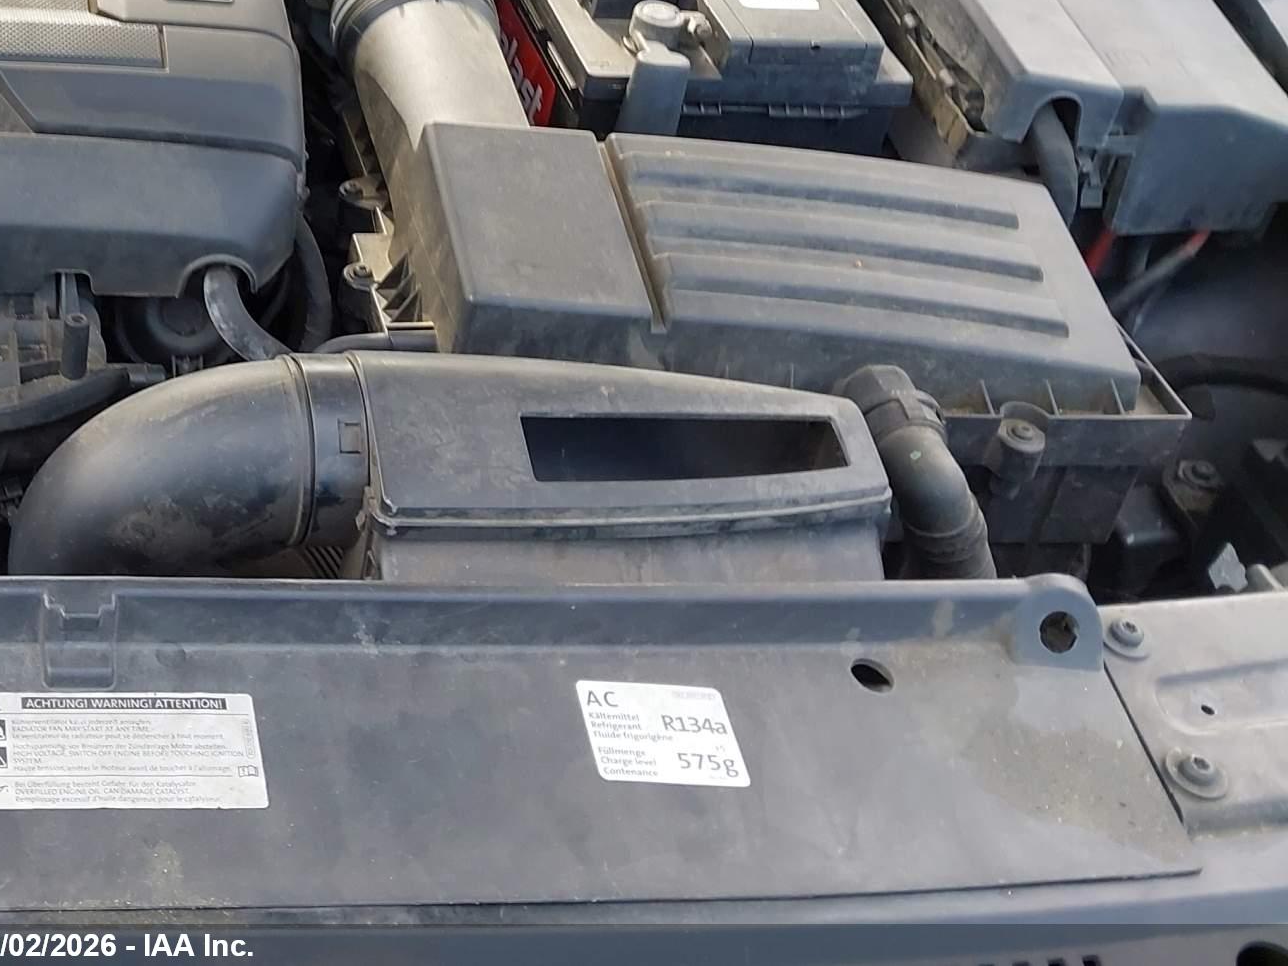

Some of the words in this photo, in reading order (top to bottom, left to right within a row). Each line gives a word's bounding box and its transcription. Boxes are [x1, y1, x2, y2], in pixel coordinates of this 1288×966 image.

[26, 697, 88, 709] ACHTUNG!
[91, 697, 153, 709] WARNING!
[155, 698, 223, 709] ATTENTION!
[590, 720, 642, 732] Refrigerant
[660, 714, 728, 735] R134a
[593, 730, 621, 739] Fluide
[600, 756, 633, 767] Charge
[634, 757, 657, 766] level
[676, 752, 739, 778] 575g
[603, 766, 659, 777] Contenance
